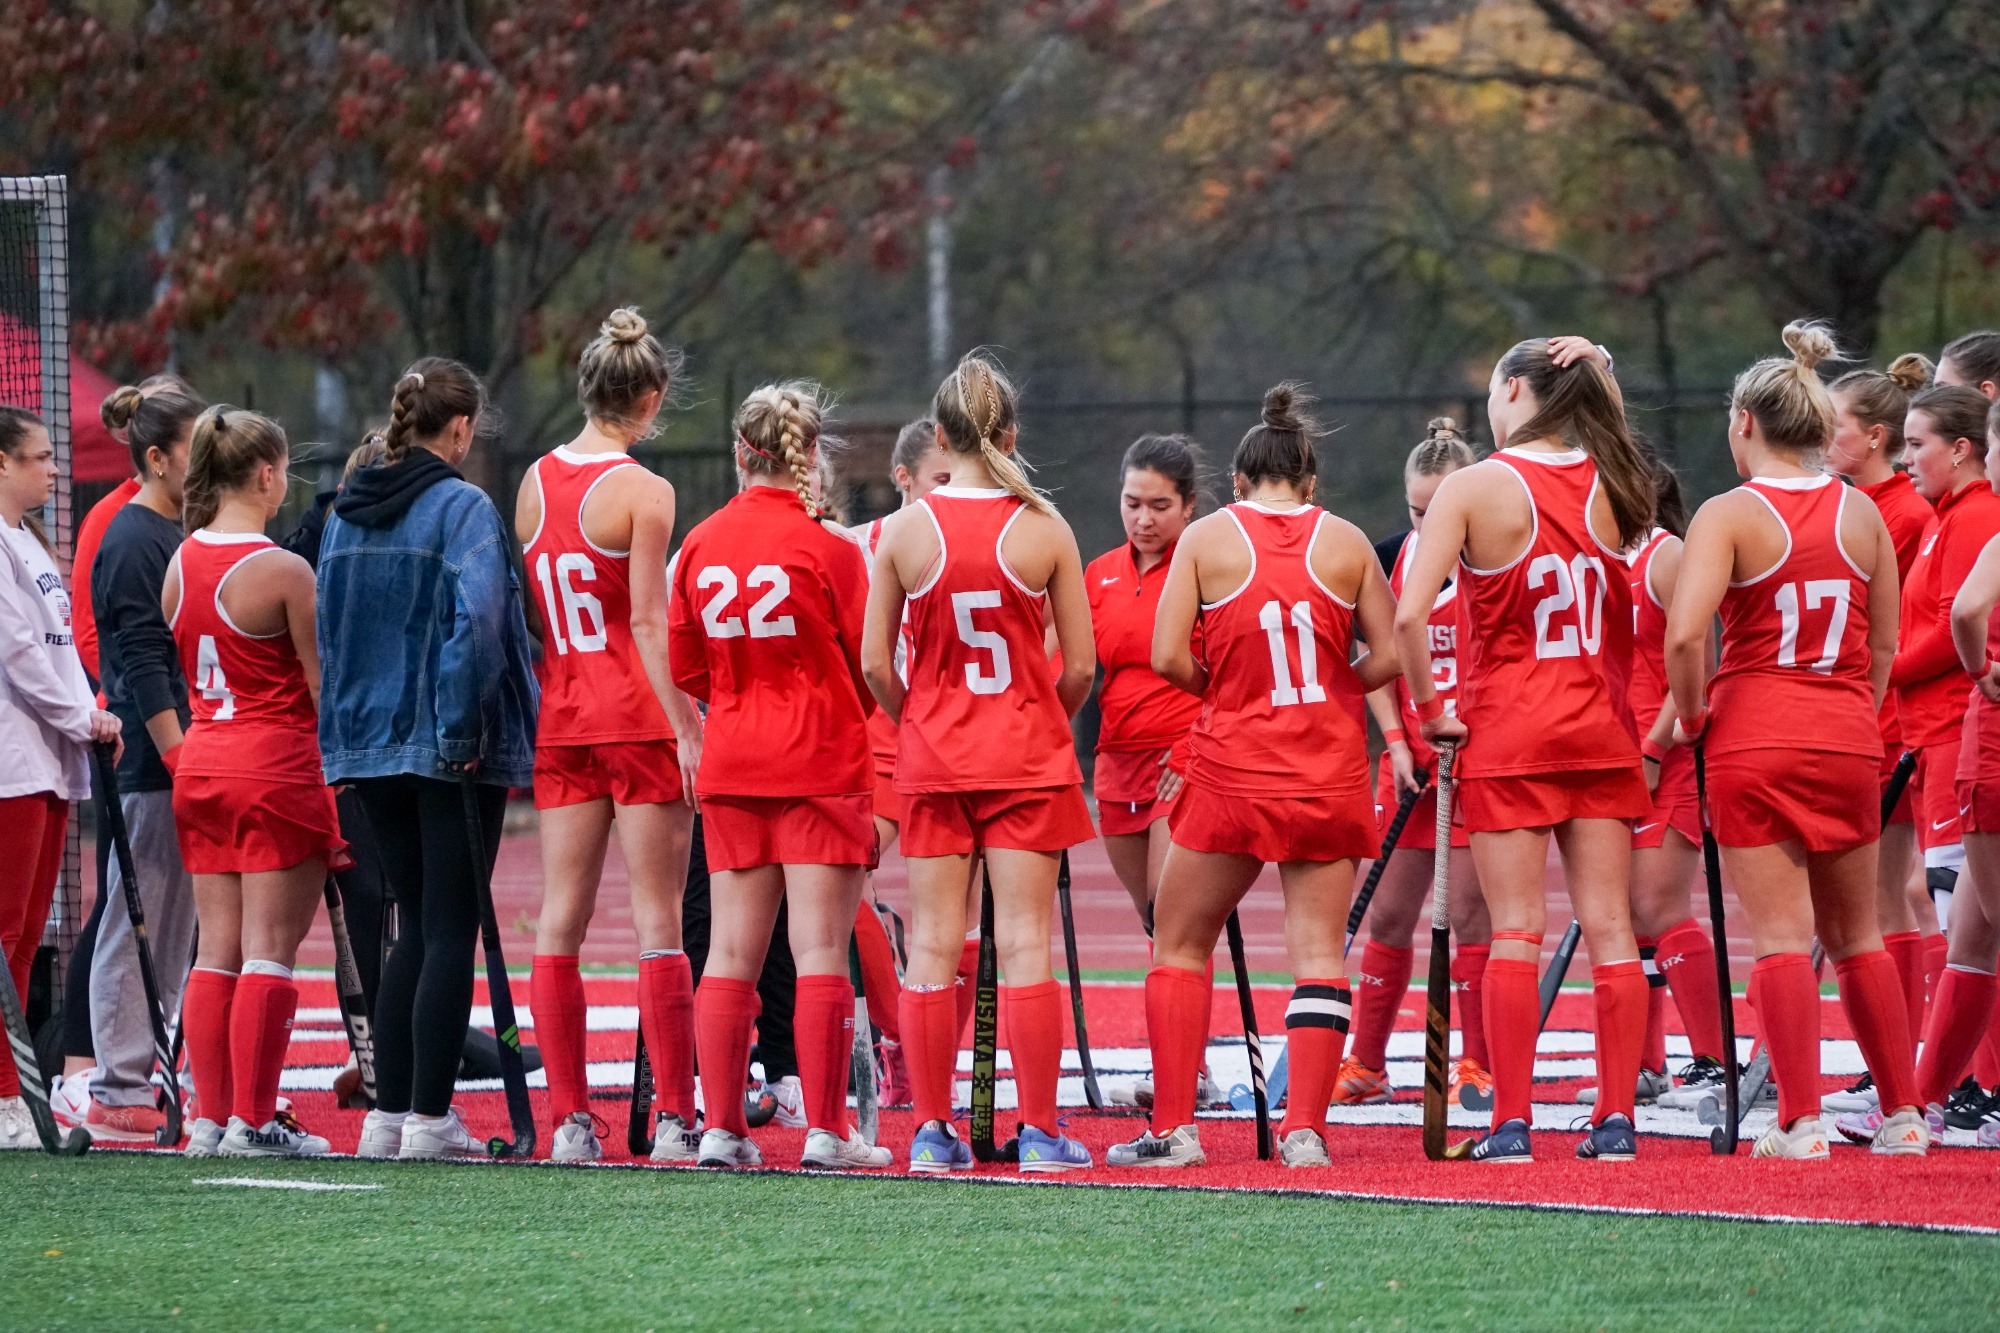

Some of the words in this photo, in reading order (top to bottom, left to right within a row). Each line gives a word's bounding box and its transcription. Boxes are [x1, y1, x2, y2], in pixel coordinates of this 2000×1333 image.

[536, 552, 608, 656] 16
[696, 564, 796, 639] 22
[951, 591, 1012, 696] 5
[1527, 553, 1607, 660] 20
[1774, 579, 1851, 676] 17
[195, 634, 237, 721] 4
[1258, 600, 1327, 707] 11
[1661, 953, 1685, 970] STX
[349, 1015, 377, 1083] Dita
[976, 985, 996, 1062] OSAKA
[245, 1129, 290, 1145] OSAKA
